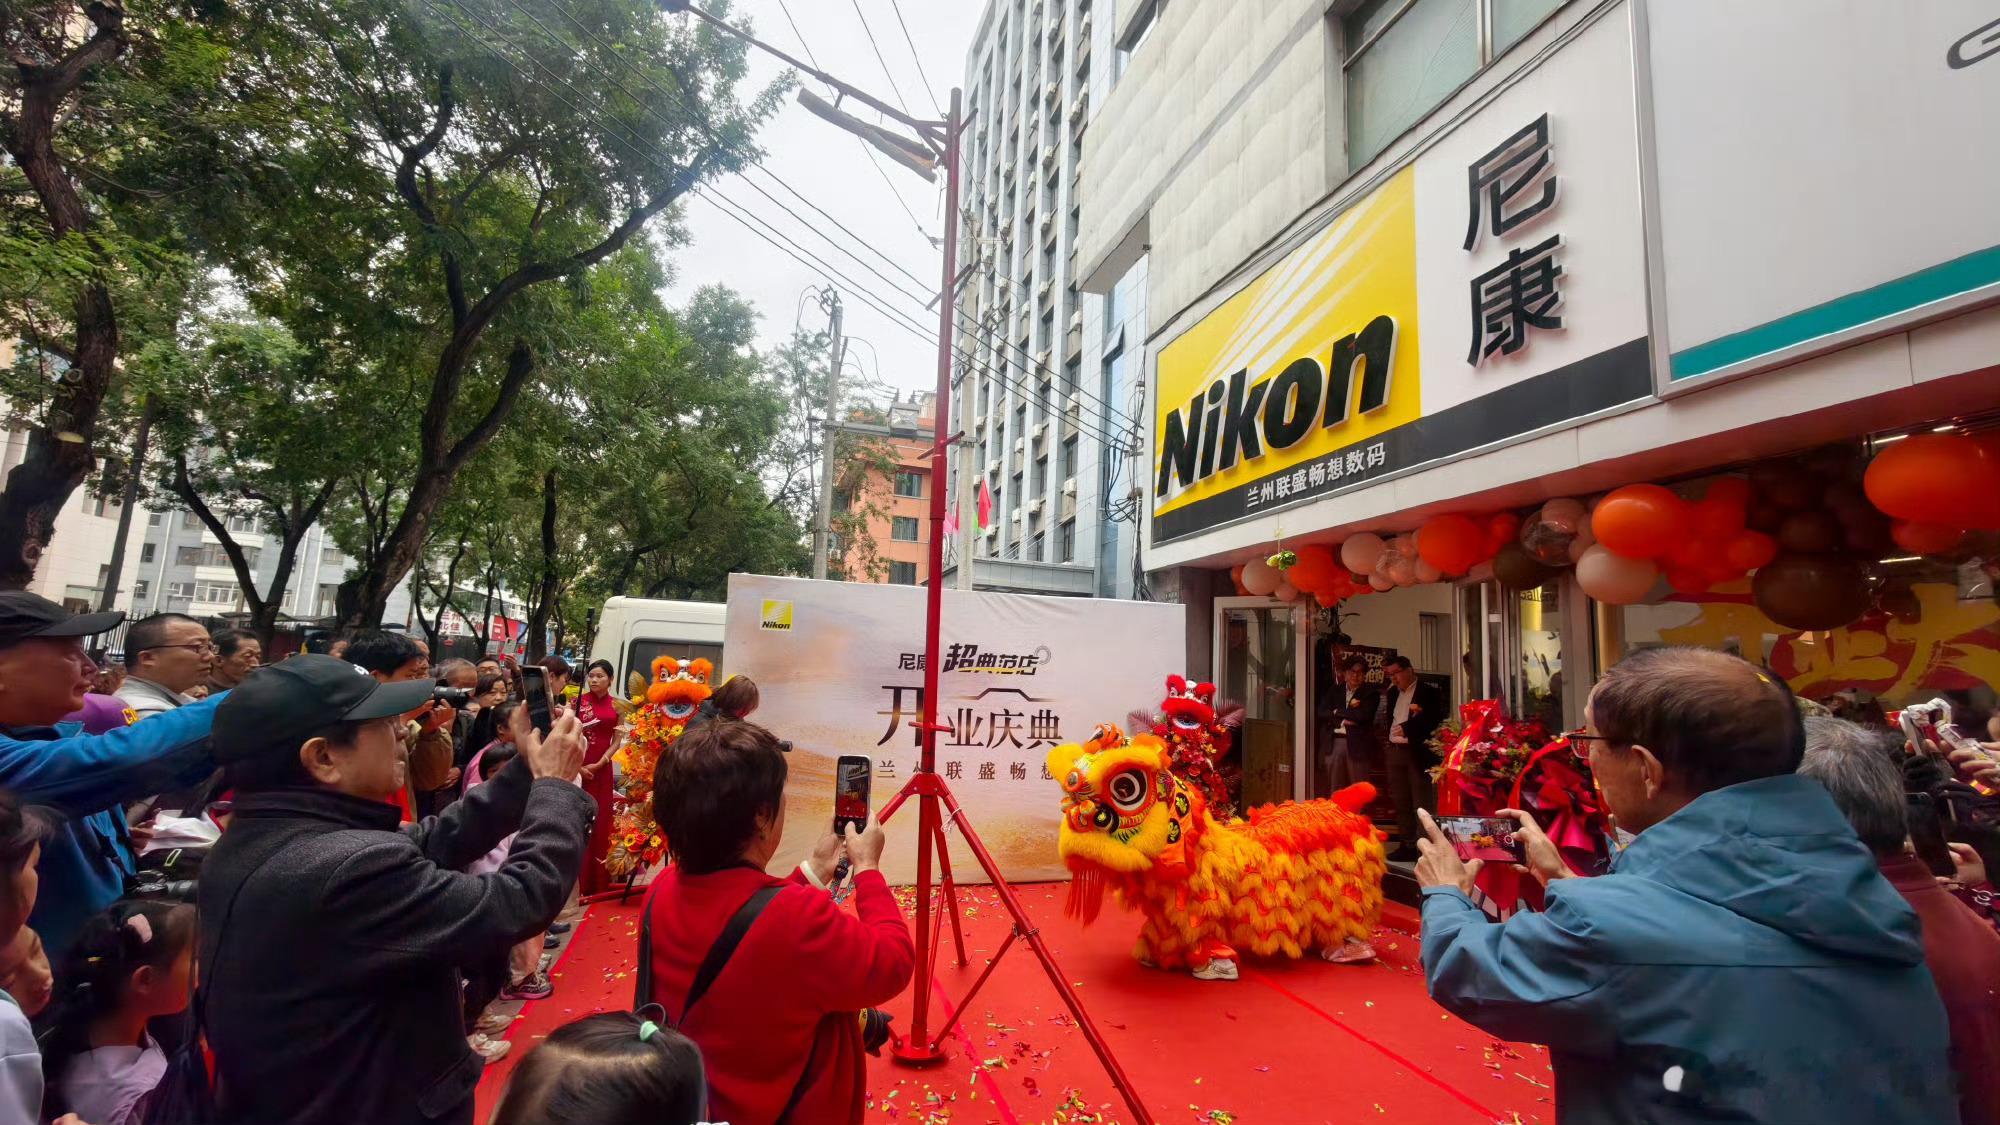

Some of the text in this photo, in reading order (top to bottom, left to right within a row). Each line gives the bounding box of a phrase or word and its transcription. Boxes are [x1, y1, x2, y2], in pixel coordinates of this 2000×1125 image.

[1463, 112, 1567, 369] 尼康
[1156, 314, 1397, 498] Nikon
[1246, 442, 1386, 508] 兰州联盛畅想数码
[761, 620, 791, 630] Nikon
[943, 642, 1039, 676] 超典范店
[877, 685, 1064, 750] 开业庆典
